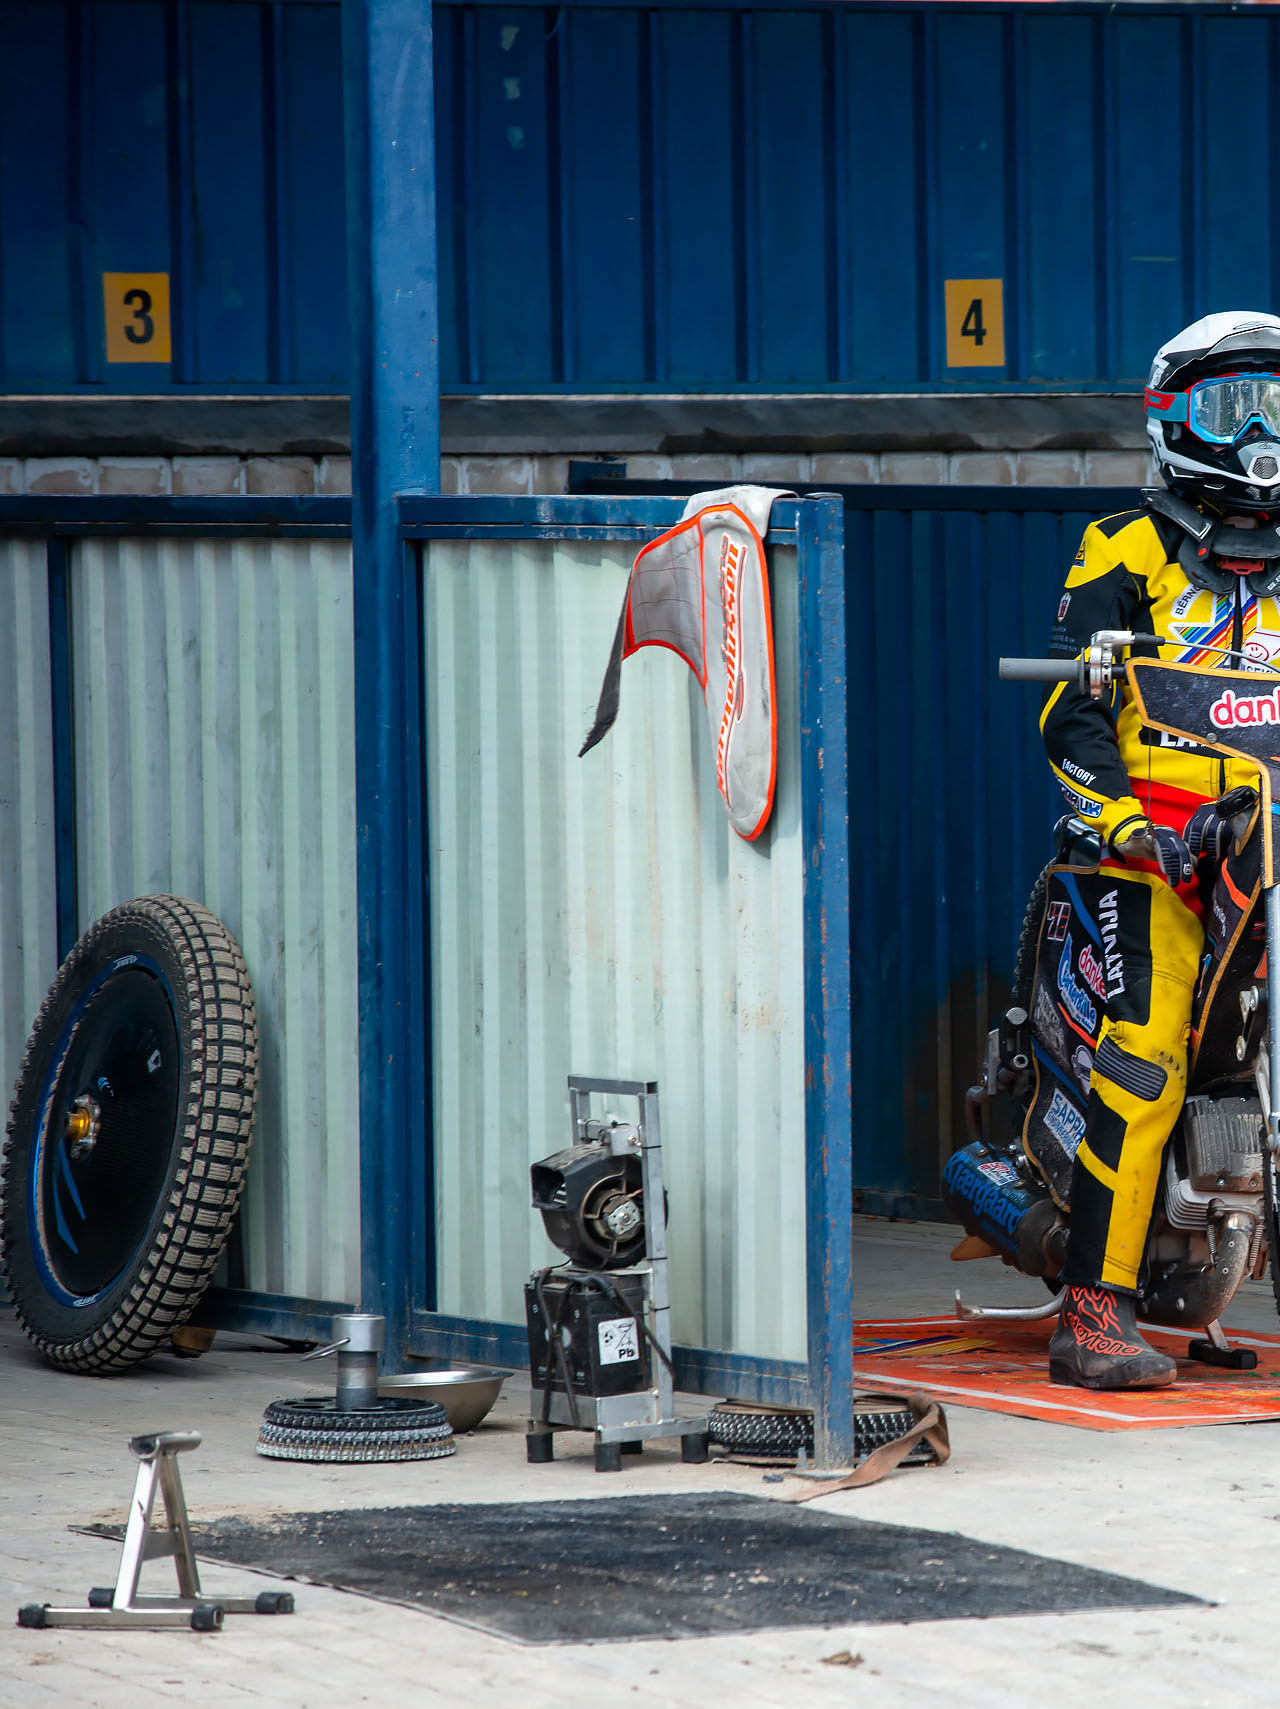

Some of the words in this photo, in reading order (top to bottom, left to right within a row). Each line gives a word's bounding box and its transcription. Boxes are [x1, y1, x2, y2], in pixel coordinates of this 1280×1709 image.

[123, 288, 154, 345] 3
[961, 298, 987, 346] 4
[1062, 758, 1097, 786] FACTORY
[1098, 889, 1126, 1000] LATVIJA
[1079, 946, 1107, 1000] danke
[1052, 1092, 1085, 1145] SAPPH
[618, 1347, 635, 1360] Pb
[1066, 1311, 1145, 1356] daytona
